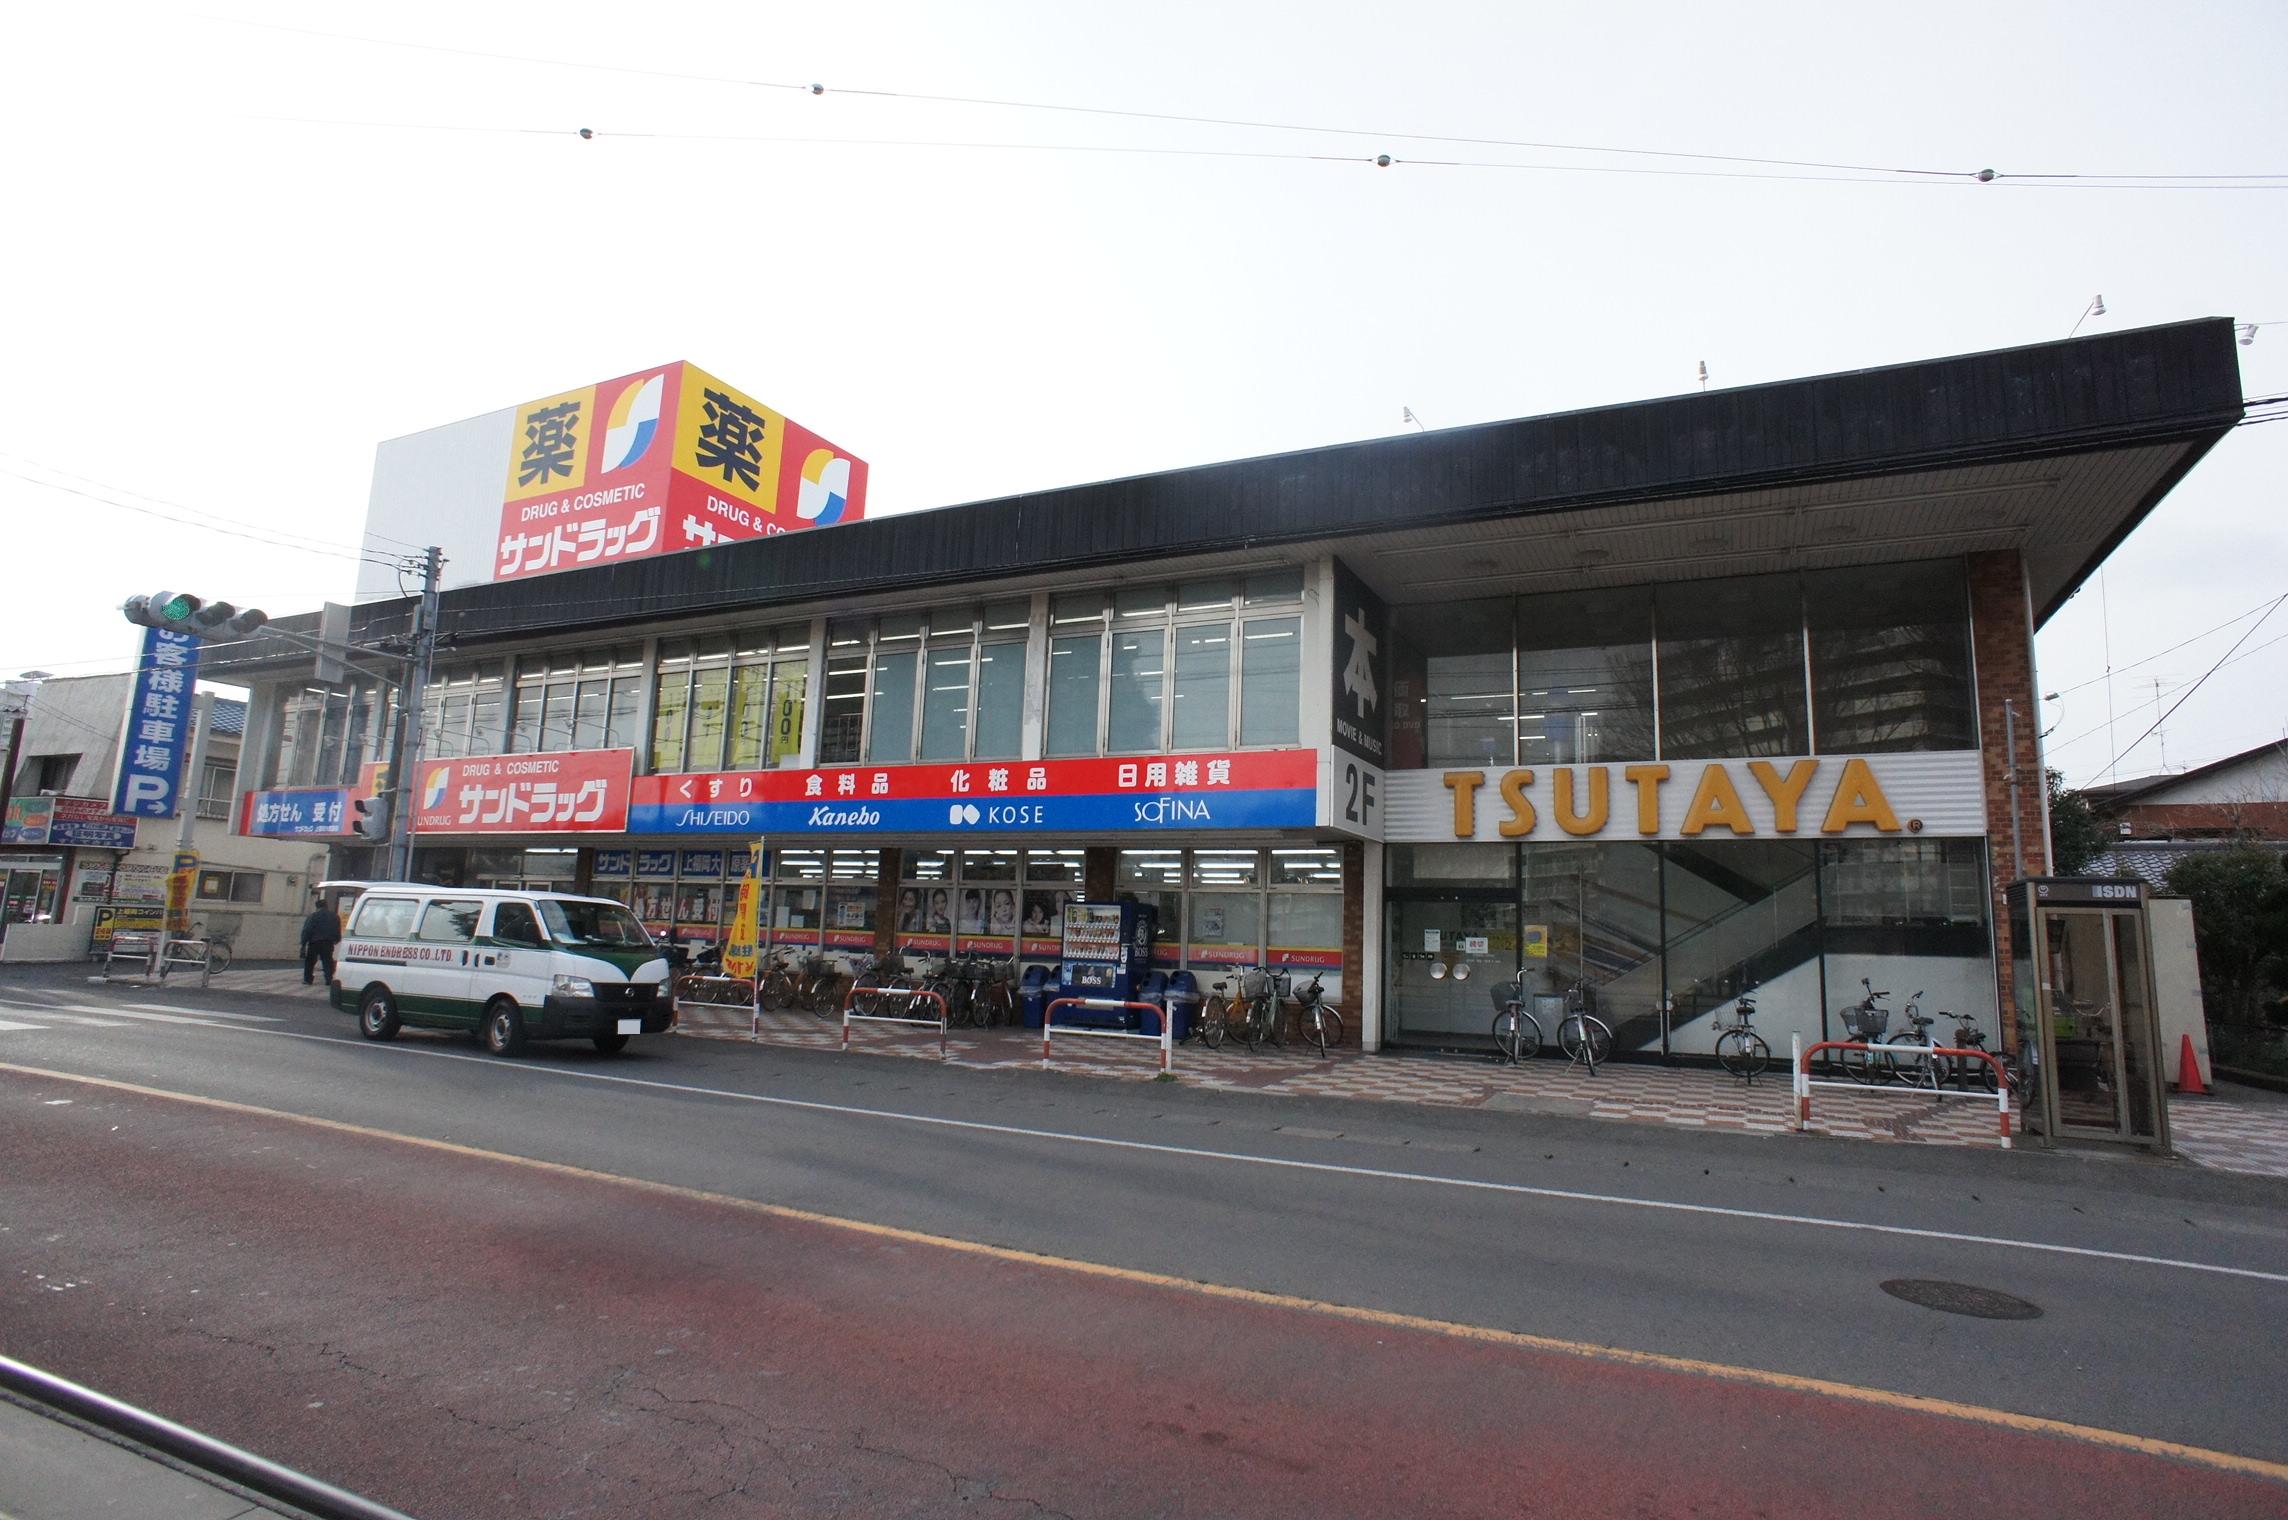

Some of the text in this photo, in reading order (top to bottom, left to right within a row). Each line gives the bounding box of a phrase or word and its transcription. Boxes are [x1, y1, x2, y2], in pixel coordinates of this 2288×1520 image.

[518, 401, 580, 488] 薬
[696, 387, 765, 493] 薬
[521, 484, 645, 522] DRUG & COSMETIC
[707, 495, 749, 526] DRUG
[753, 517, 762, 530] &
[499, 506, 661, 575] サンドラッグ
[1344, 608, 1377, 719] 本
[1336, 718, 1358, 745] MOVIE
[1364, 735, 1382, 756] MUSIC
[463, 760, 559, 776] DRUG & COSMETIC
[680, 759, 1231, 799] くすり 食料品 化粧品 日用雑貨
[124, 774, 169, 812] P
[312, 801, 342, 823] 受付
[459, 779, 607, 824] サンドラッグ
[1346, 764, 1375, 826] 2F
[1443, 758, 1902, 837] TSUTAYA
[417, 816, 451, 826] UNDRUG
[676, 810, 750, 827] SHISEIDO
[808, 806, 880, 826] Kanebo
[989, 806, 1043, 824] KOSE
[2092, 885, 2137, 898] ISDN
[347, 943, 379, 957] NIPPON
[1208, 951, 1245, 959] SUNDRUG
[1291, 955, 1325, 963] SUNDRUG
[1081, 976, 1102, 985] BOSS
